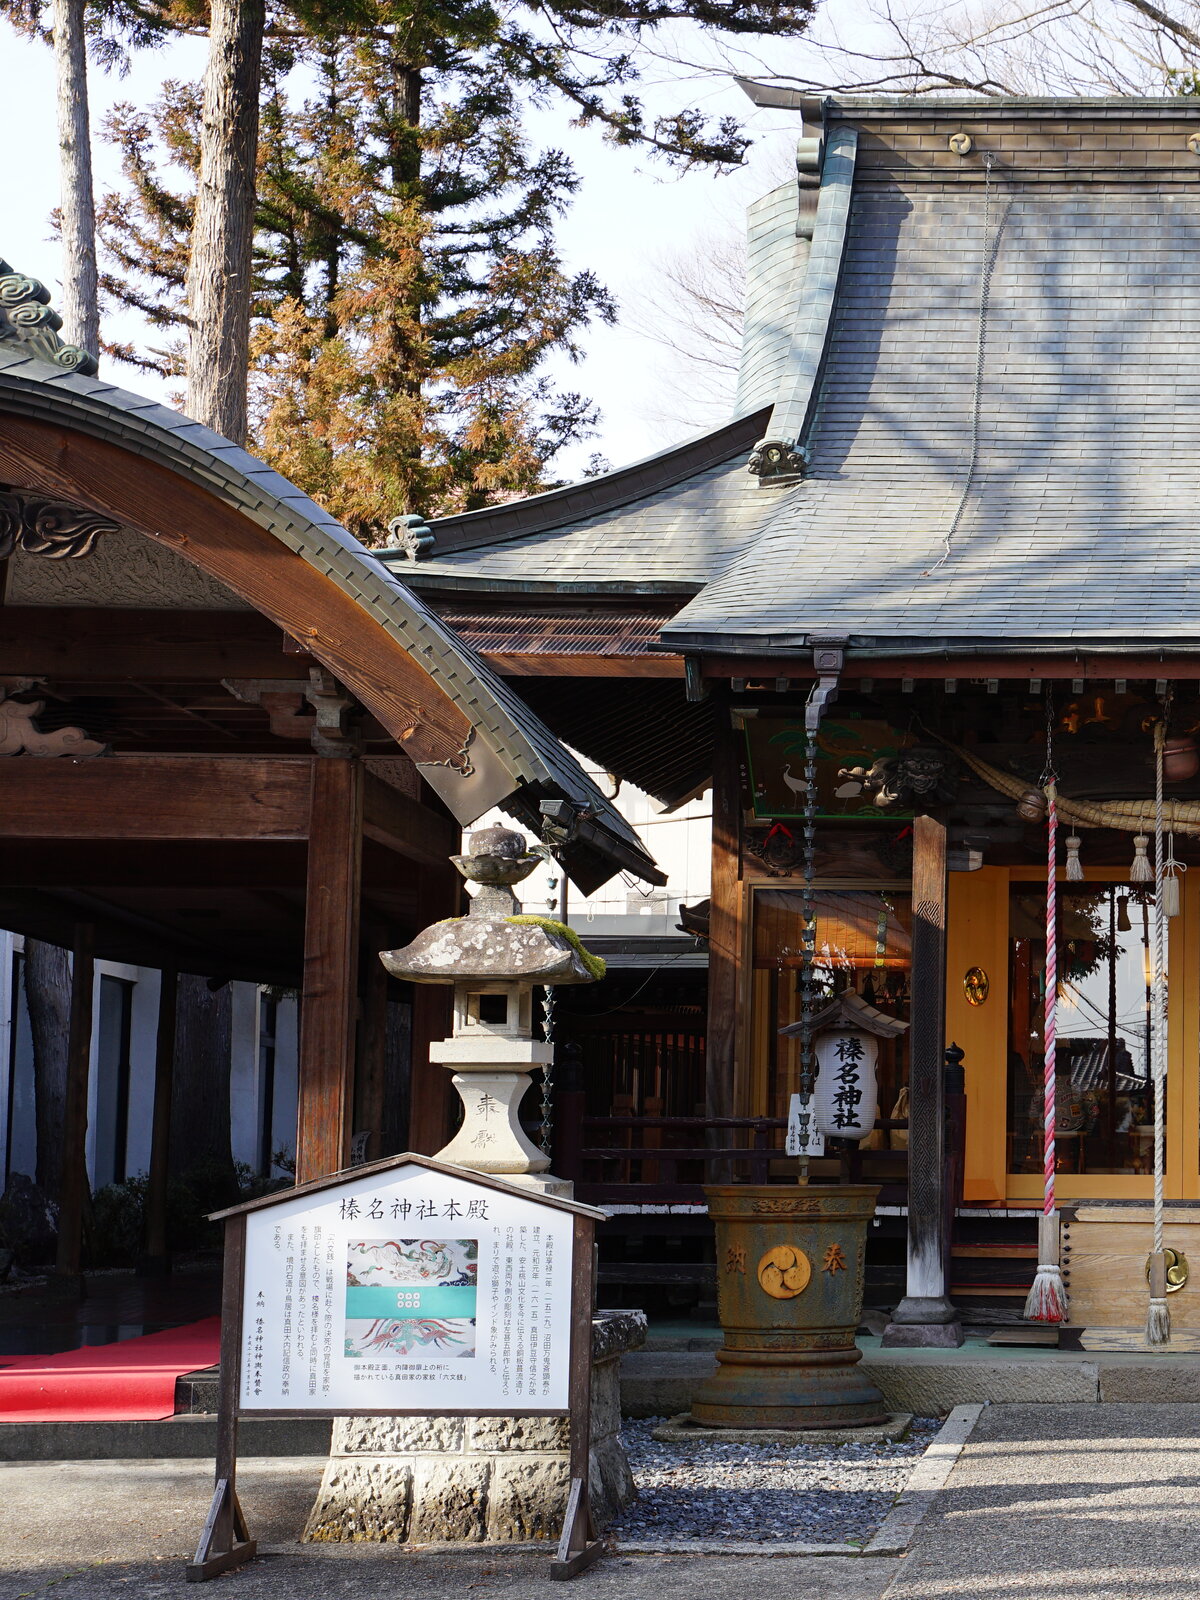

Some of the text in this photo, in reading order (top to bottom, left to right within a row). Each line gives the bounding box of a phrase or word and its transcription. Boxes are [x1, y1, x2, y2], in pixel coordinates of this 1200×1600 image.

[830, 1037, 867, 1130] 榛名神社
[338, 1197, 490, 1221] 榛名神社本殿
[725, 1241, 848, 1276] 奉 納
